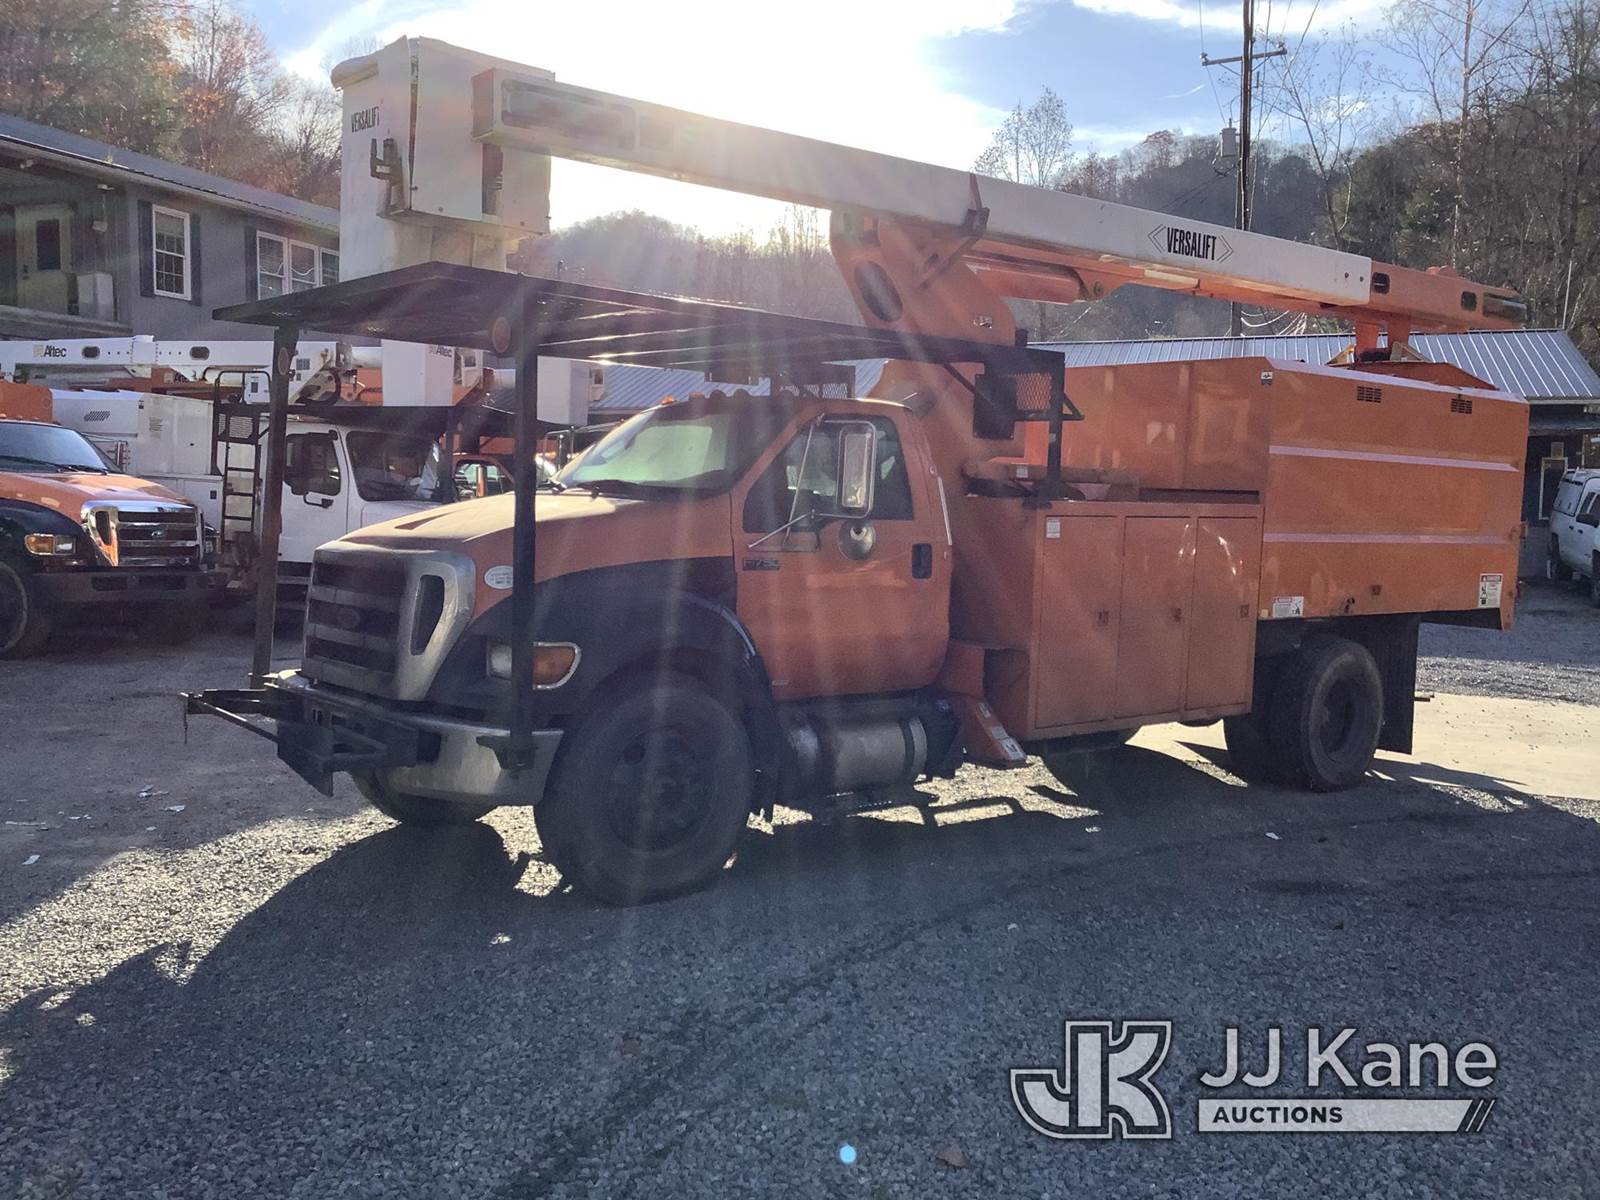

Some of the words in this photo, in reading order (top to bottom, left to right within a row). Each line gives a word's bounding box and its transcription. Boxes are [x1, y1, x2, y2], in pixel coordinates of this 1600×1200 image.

[351, 106, 380, 133] VERSALIFT
[1167, 227, 1217, 261] VERSALIFT
[43, 344, 67, 358] Altec
